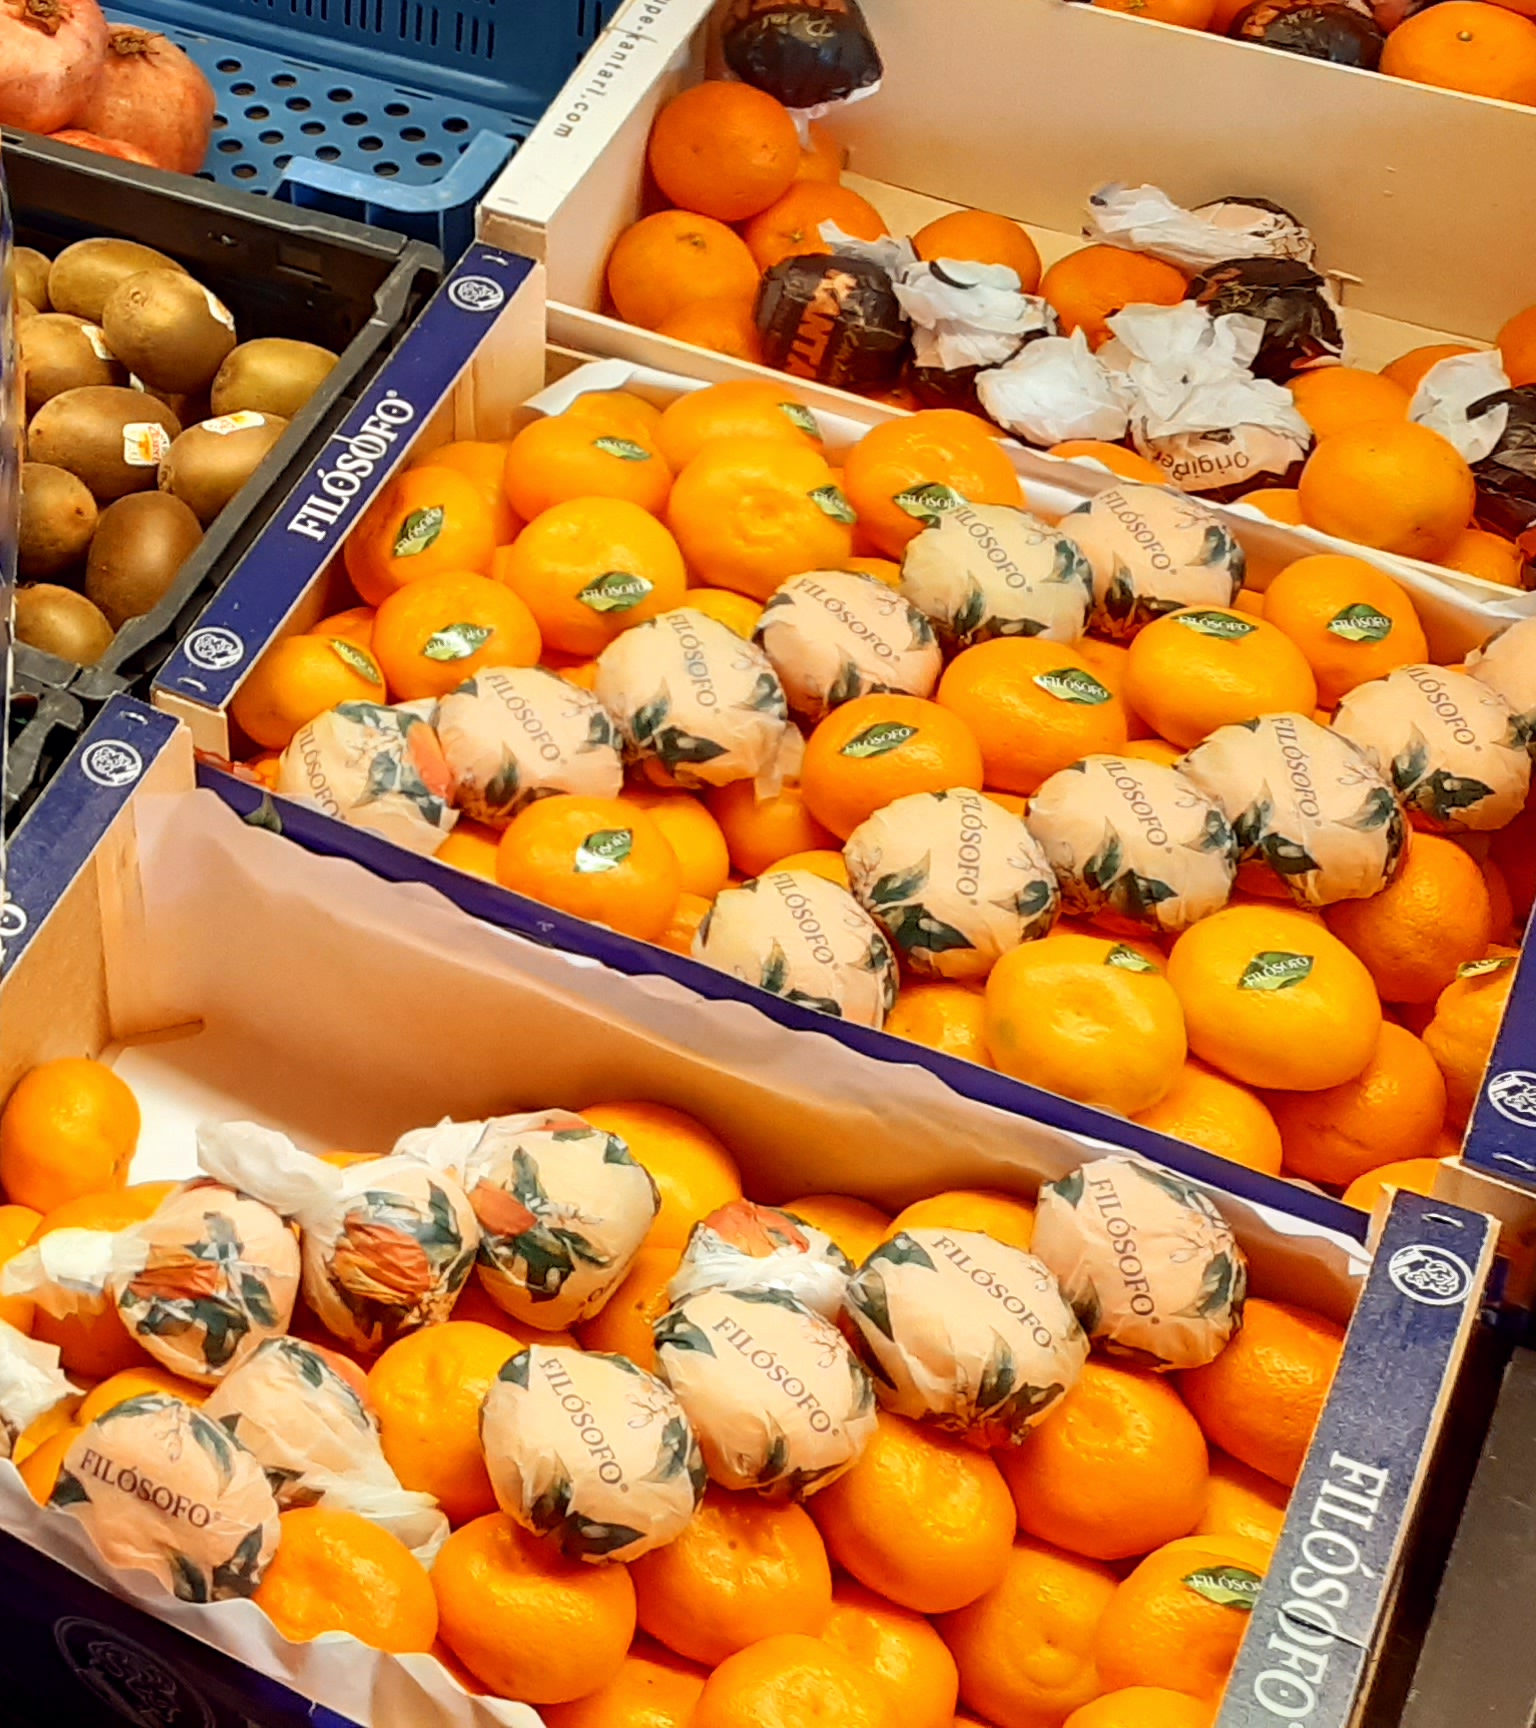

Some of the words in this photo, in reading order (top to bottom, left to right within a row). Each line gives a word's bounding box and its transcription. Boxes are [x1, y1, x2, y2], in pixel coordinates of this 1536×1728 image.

[287, 397, 414, 543] FILÓSOFO
[1098, 489, 1171, 572] FILÓSOFO
[667, 613, 718, 708] FILÓSOFO
[793, 577, 893, 660] FILÓSOFO
[485, 672, 561, 763] FILÓSOFO
[1270, 715, 1322, 820] FILÓSOFO
[767, 871, 836, 966] FILÓSOFO
[1243, 955, 1312, 986] FILÓSOFO
[930, 1233, 1054, 1351] FILÓSOFO
[1088, 1176, 1156, 1320] FILÓSOFO
[539, 1356, 624, 1487] FILÓSOFO
[712, 1315, 833, 1435] FILÓSOFO
[78, 1447, 212, 1529] FILÓSOFO
[1253, 1450, 1390, 1719] FILÓSOFO
